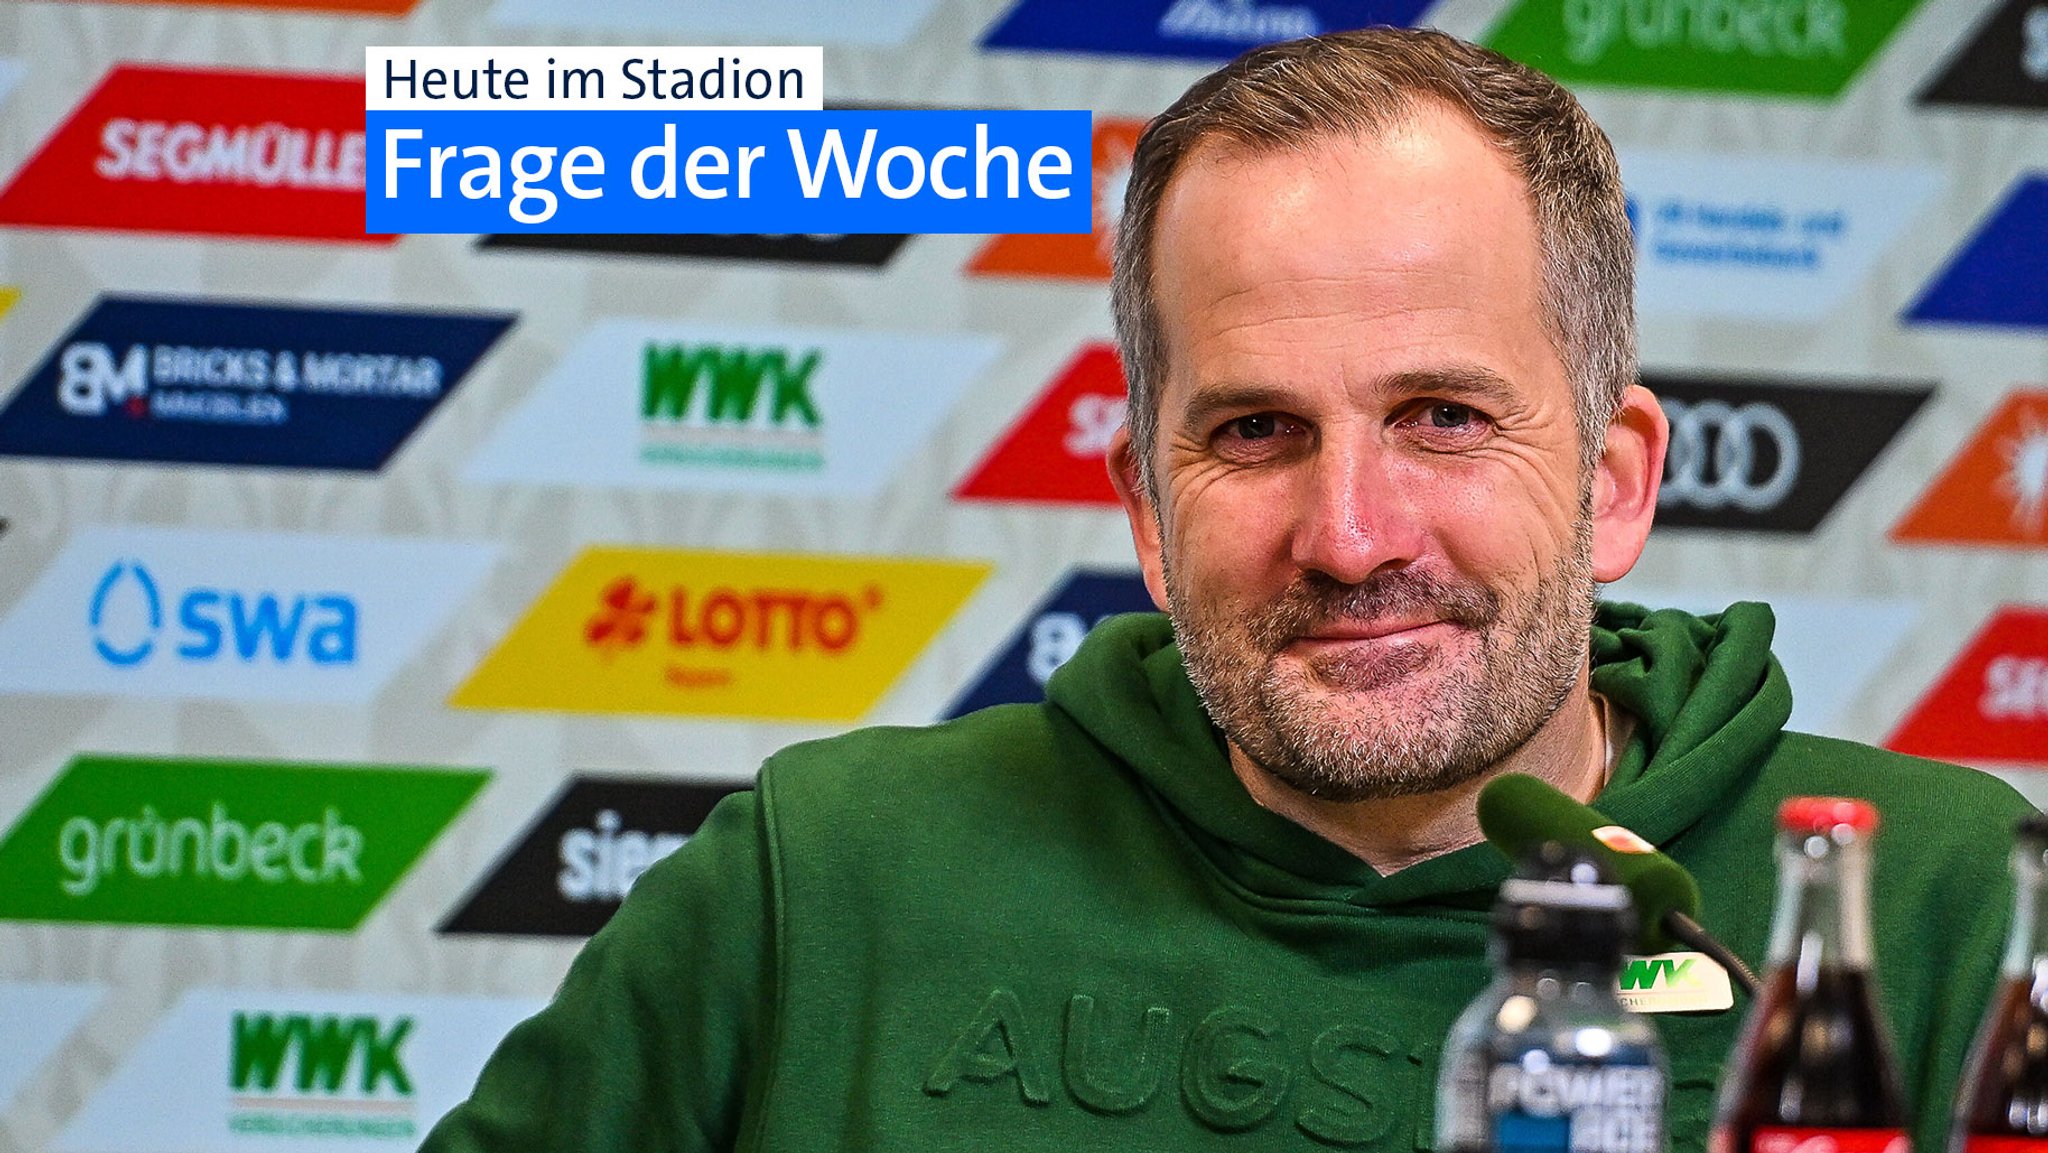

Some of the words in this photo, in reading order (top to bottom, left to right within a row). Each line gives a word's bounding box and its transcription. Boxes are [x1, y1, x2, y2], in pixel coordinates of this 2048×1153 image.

[95, 118, 366, 192] SEGMÜLLE
[641, 341, 824, 427] WWK
[177, 588, 358, 664] swa
[667, 585, 858, 653] LOTTO
[58, 801, 364, 896] grünbeck
[1620, 959, 1697, 990] WK
[230, 1011, 414, 1096] WWK
[922, 988, 1440, 1152] AUGS
